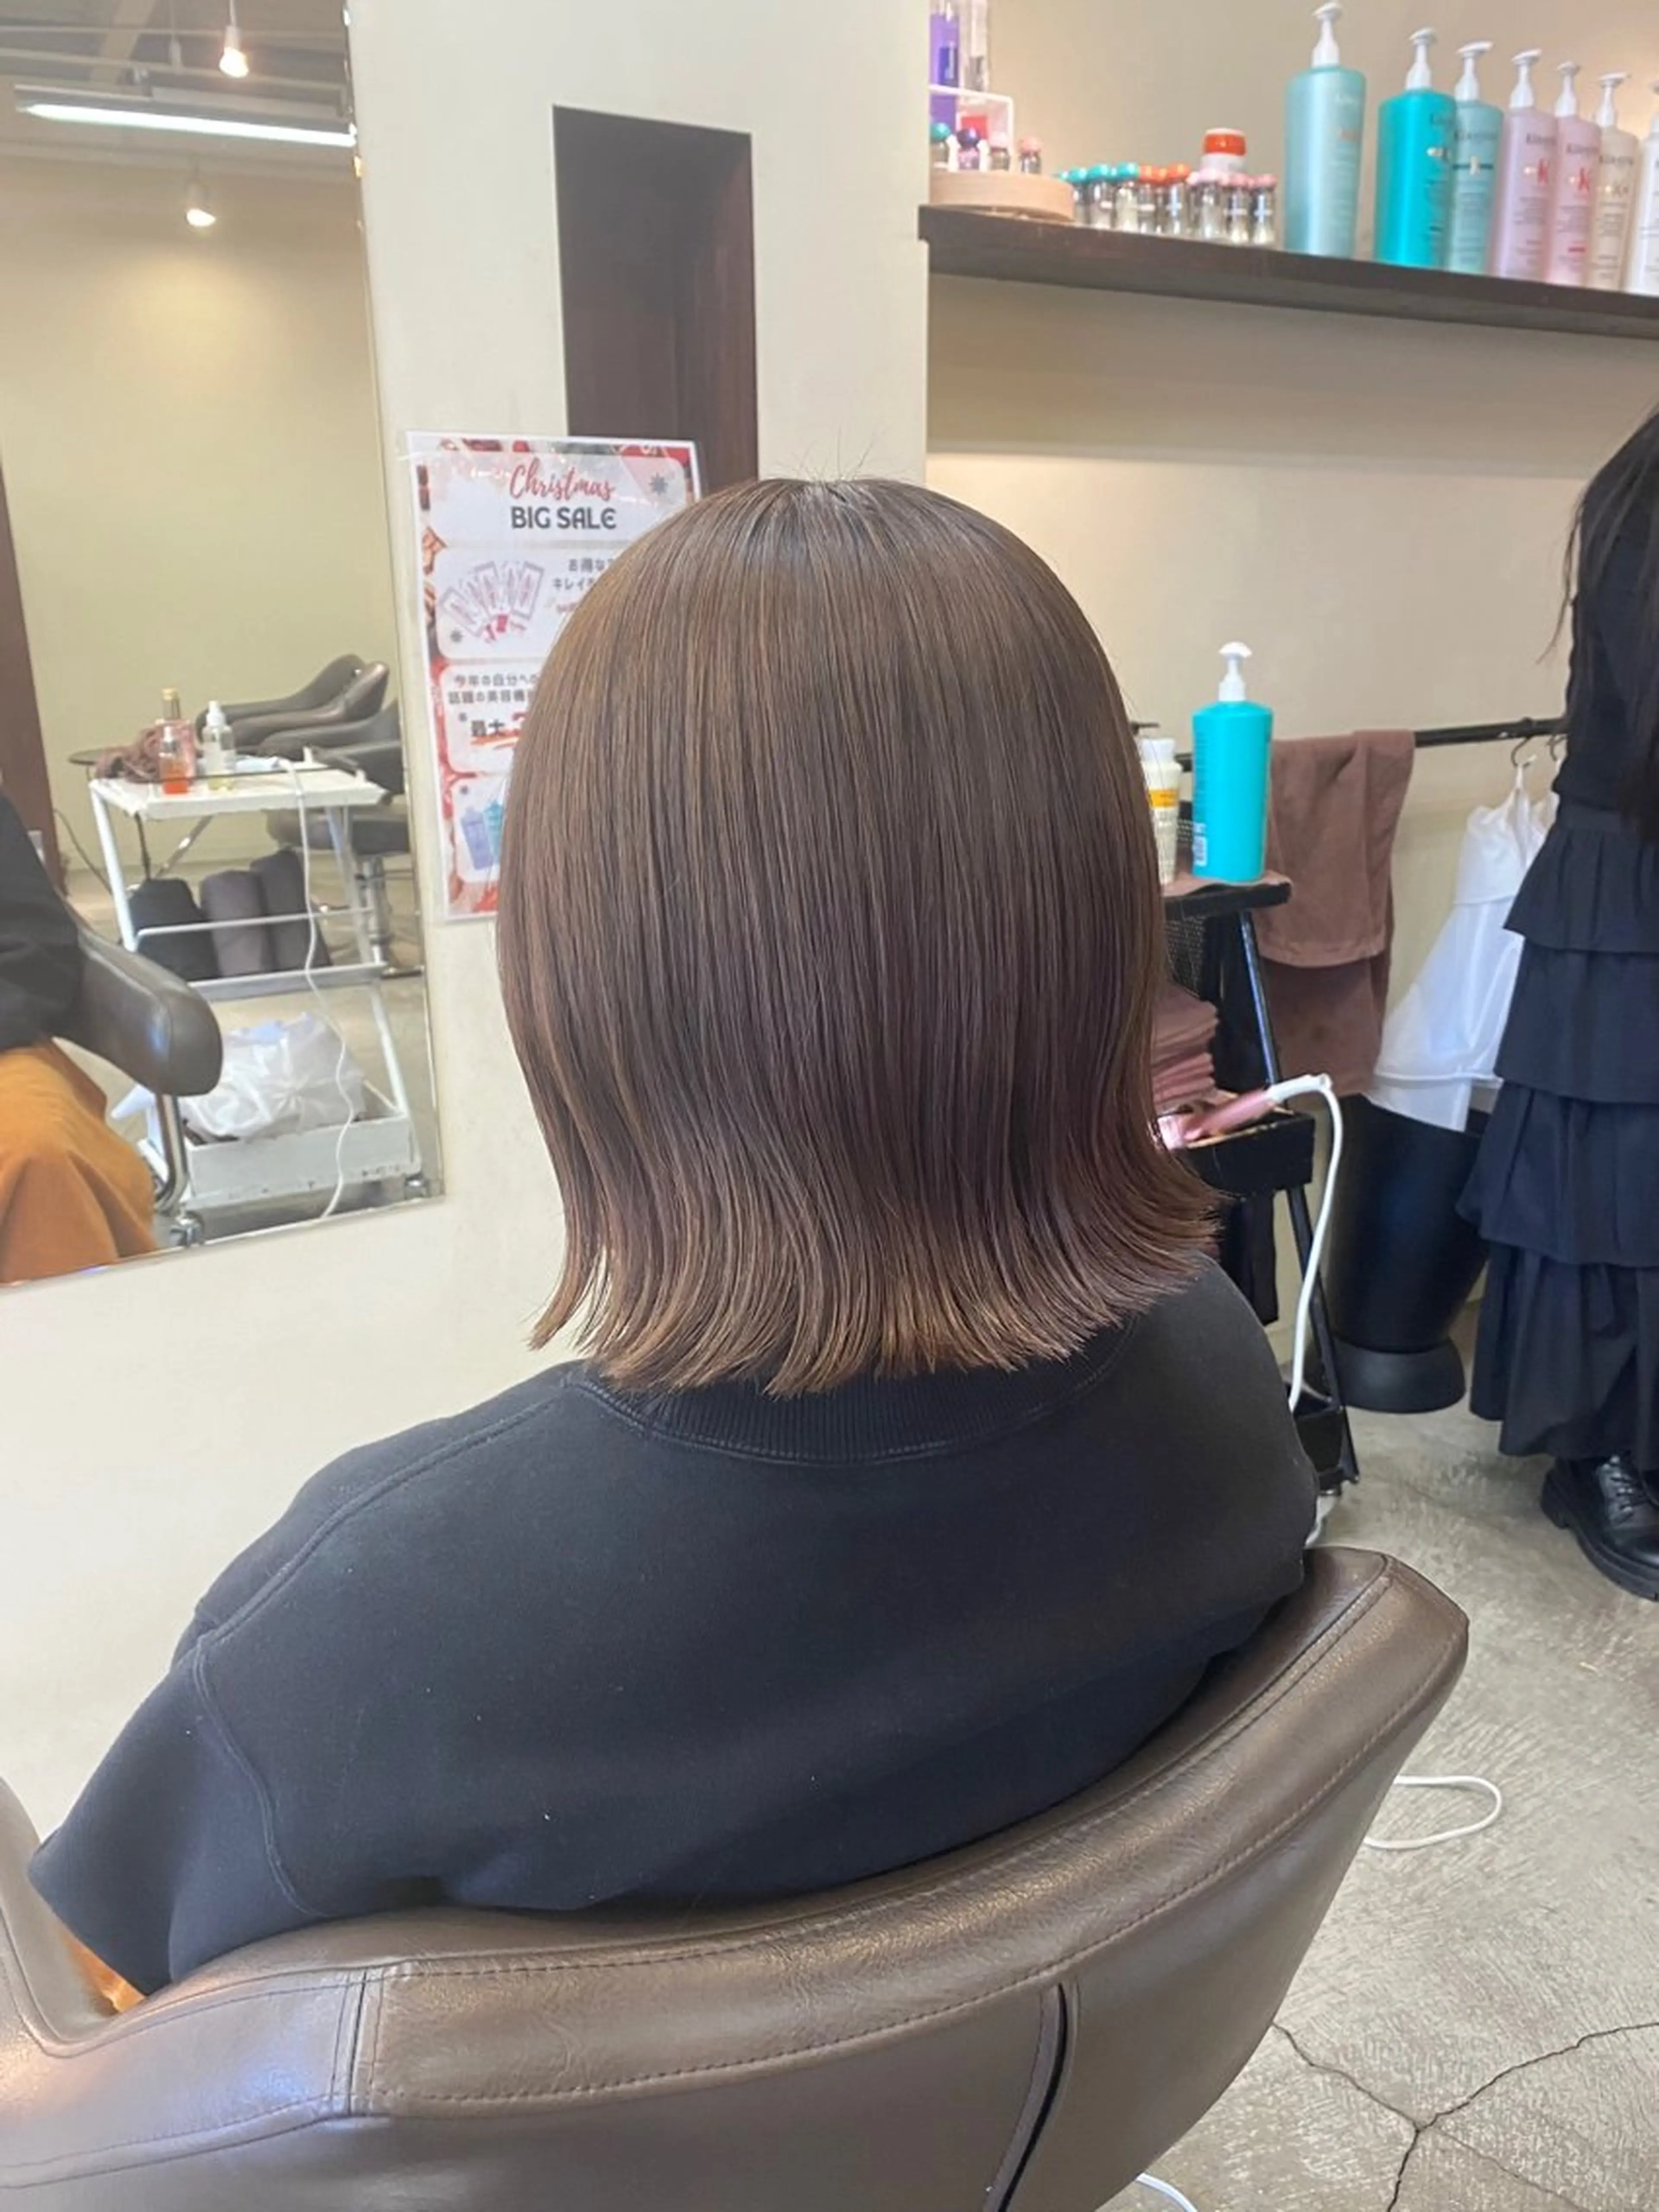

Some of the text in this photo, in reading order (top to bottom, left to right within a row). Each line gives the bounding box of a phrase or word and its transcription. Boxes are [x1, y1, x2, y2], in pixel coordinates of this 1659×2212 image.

[510, 456, 616, 502] Christmas
[511, 506, 617, 529] BIG SALE
